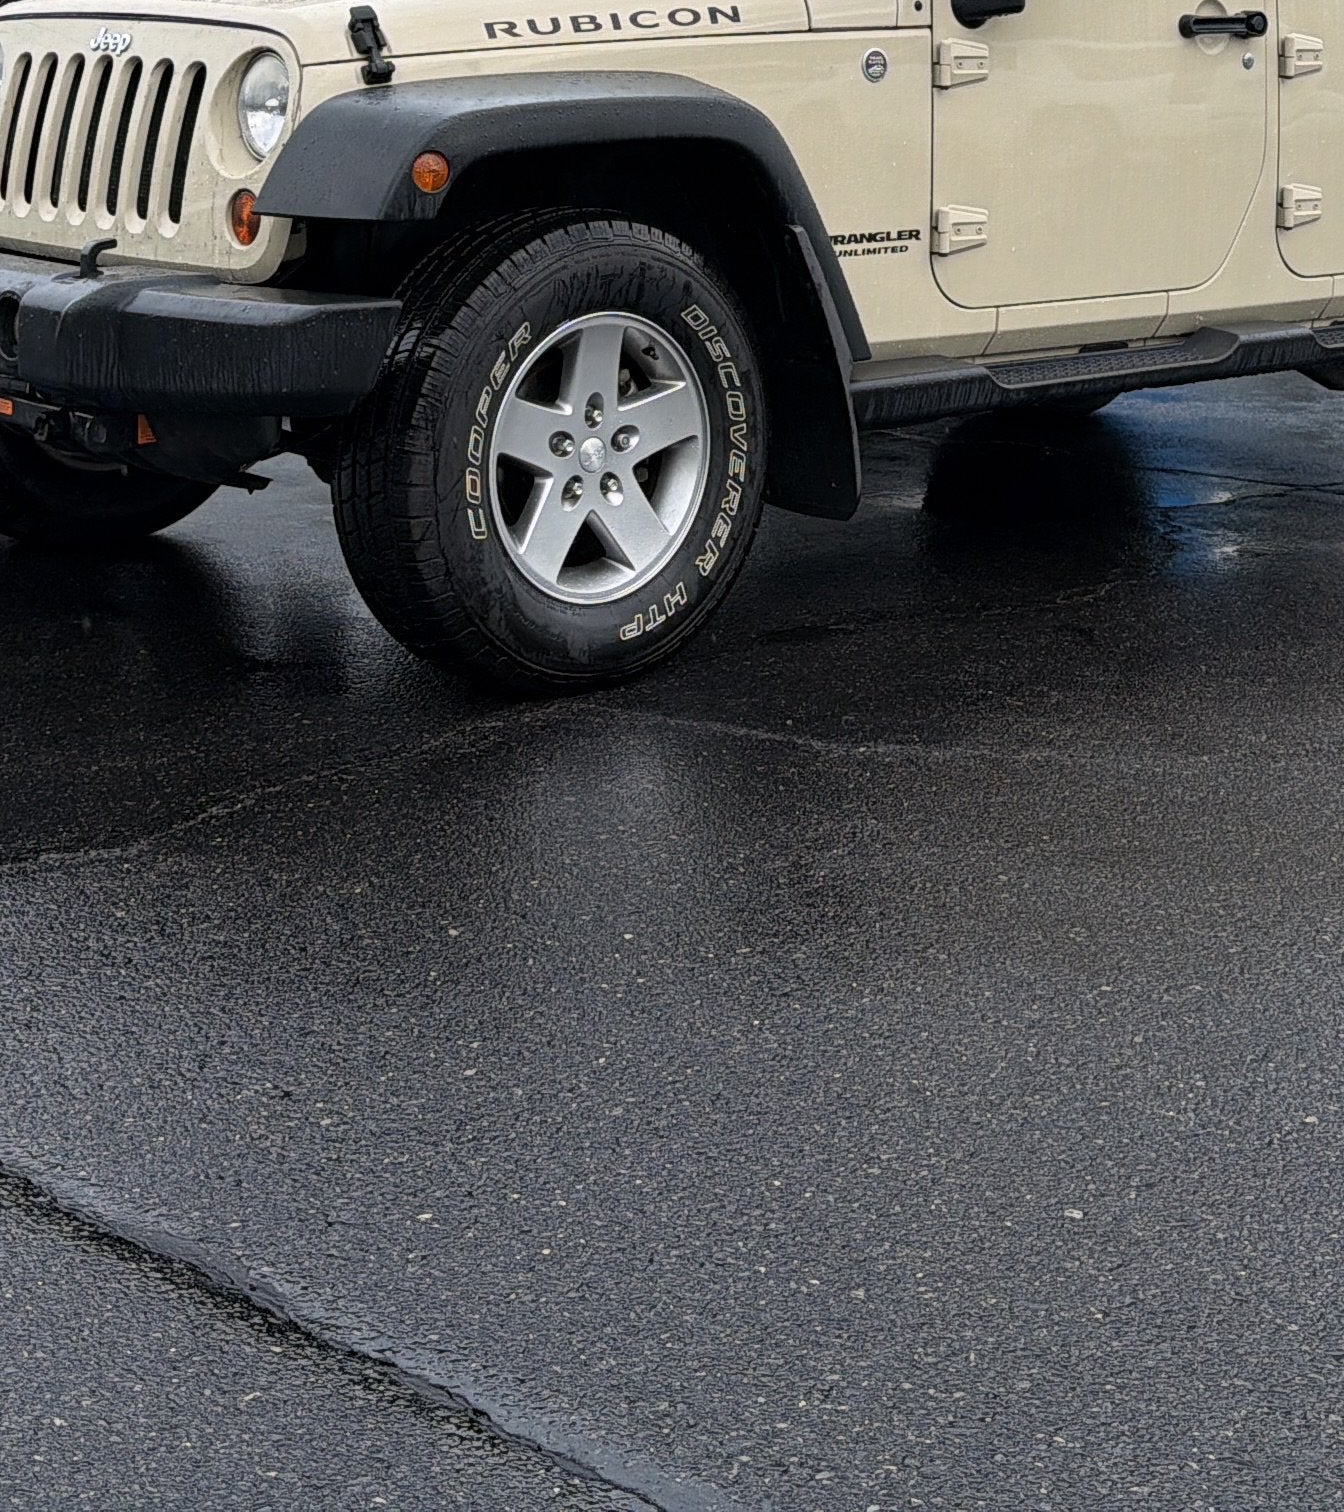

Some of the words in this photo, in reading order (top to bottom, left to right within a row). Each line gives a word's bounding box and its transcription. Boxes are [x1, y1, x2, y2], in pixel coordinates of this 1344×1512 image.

[90, 27, 132, 57] Jeep
[484, 5, 741, 39] RUBICON
[829, 229, 921, 245] RANGLER
[466, 322, 531, 539] COOPER
[681, 304, 748, 576] DISCOVERER
[620, 582, 687, 640] HTP
